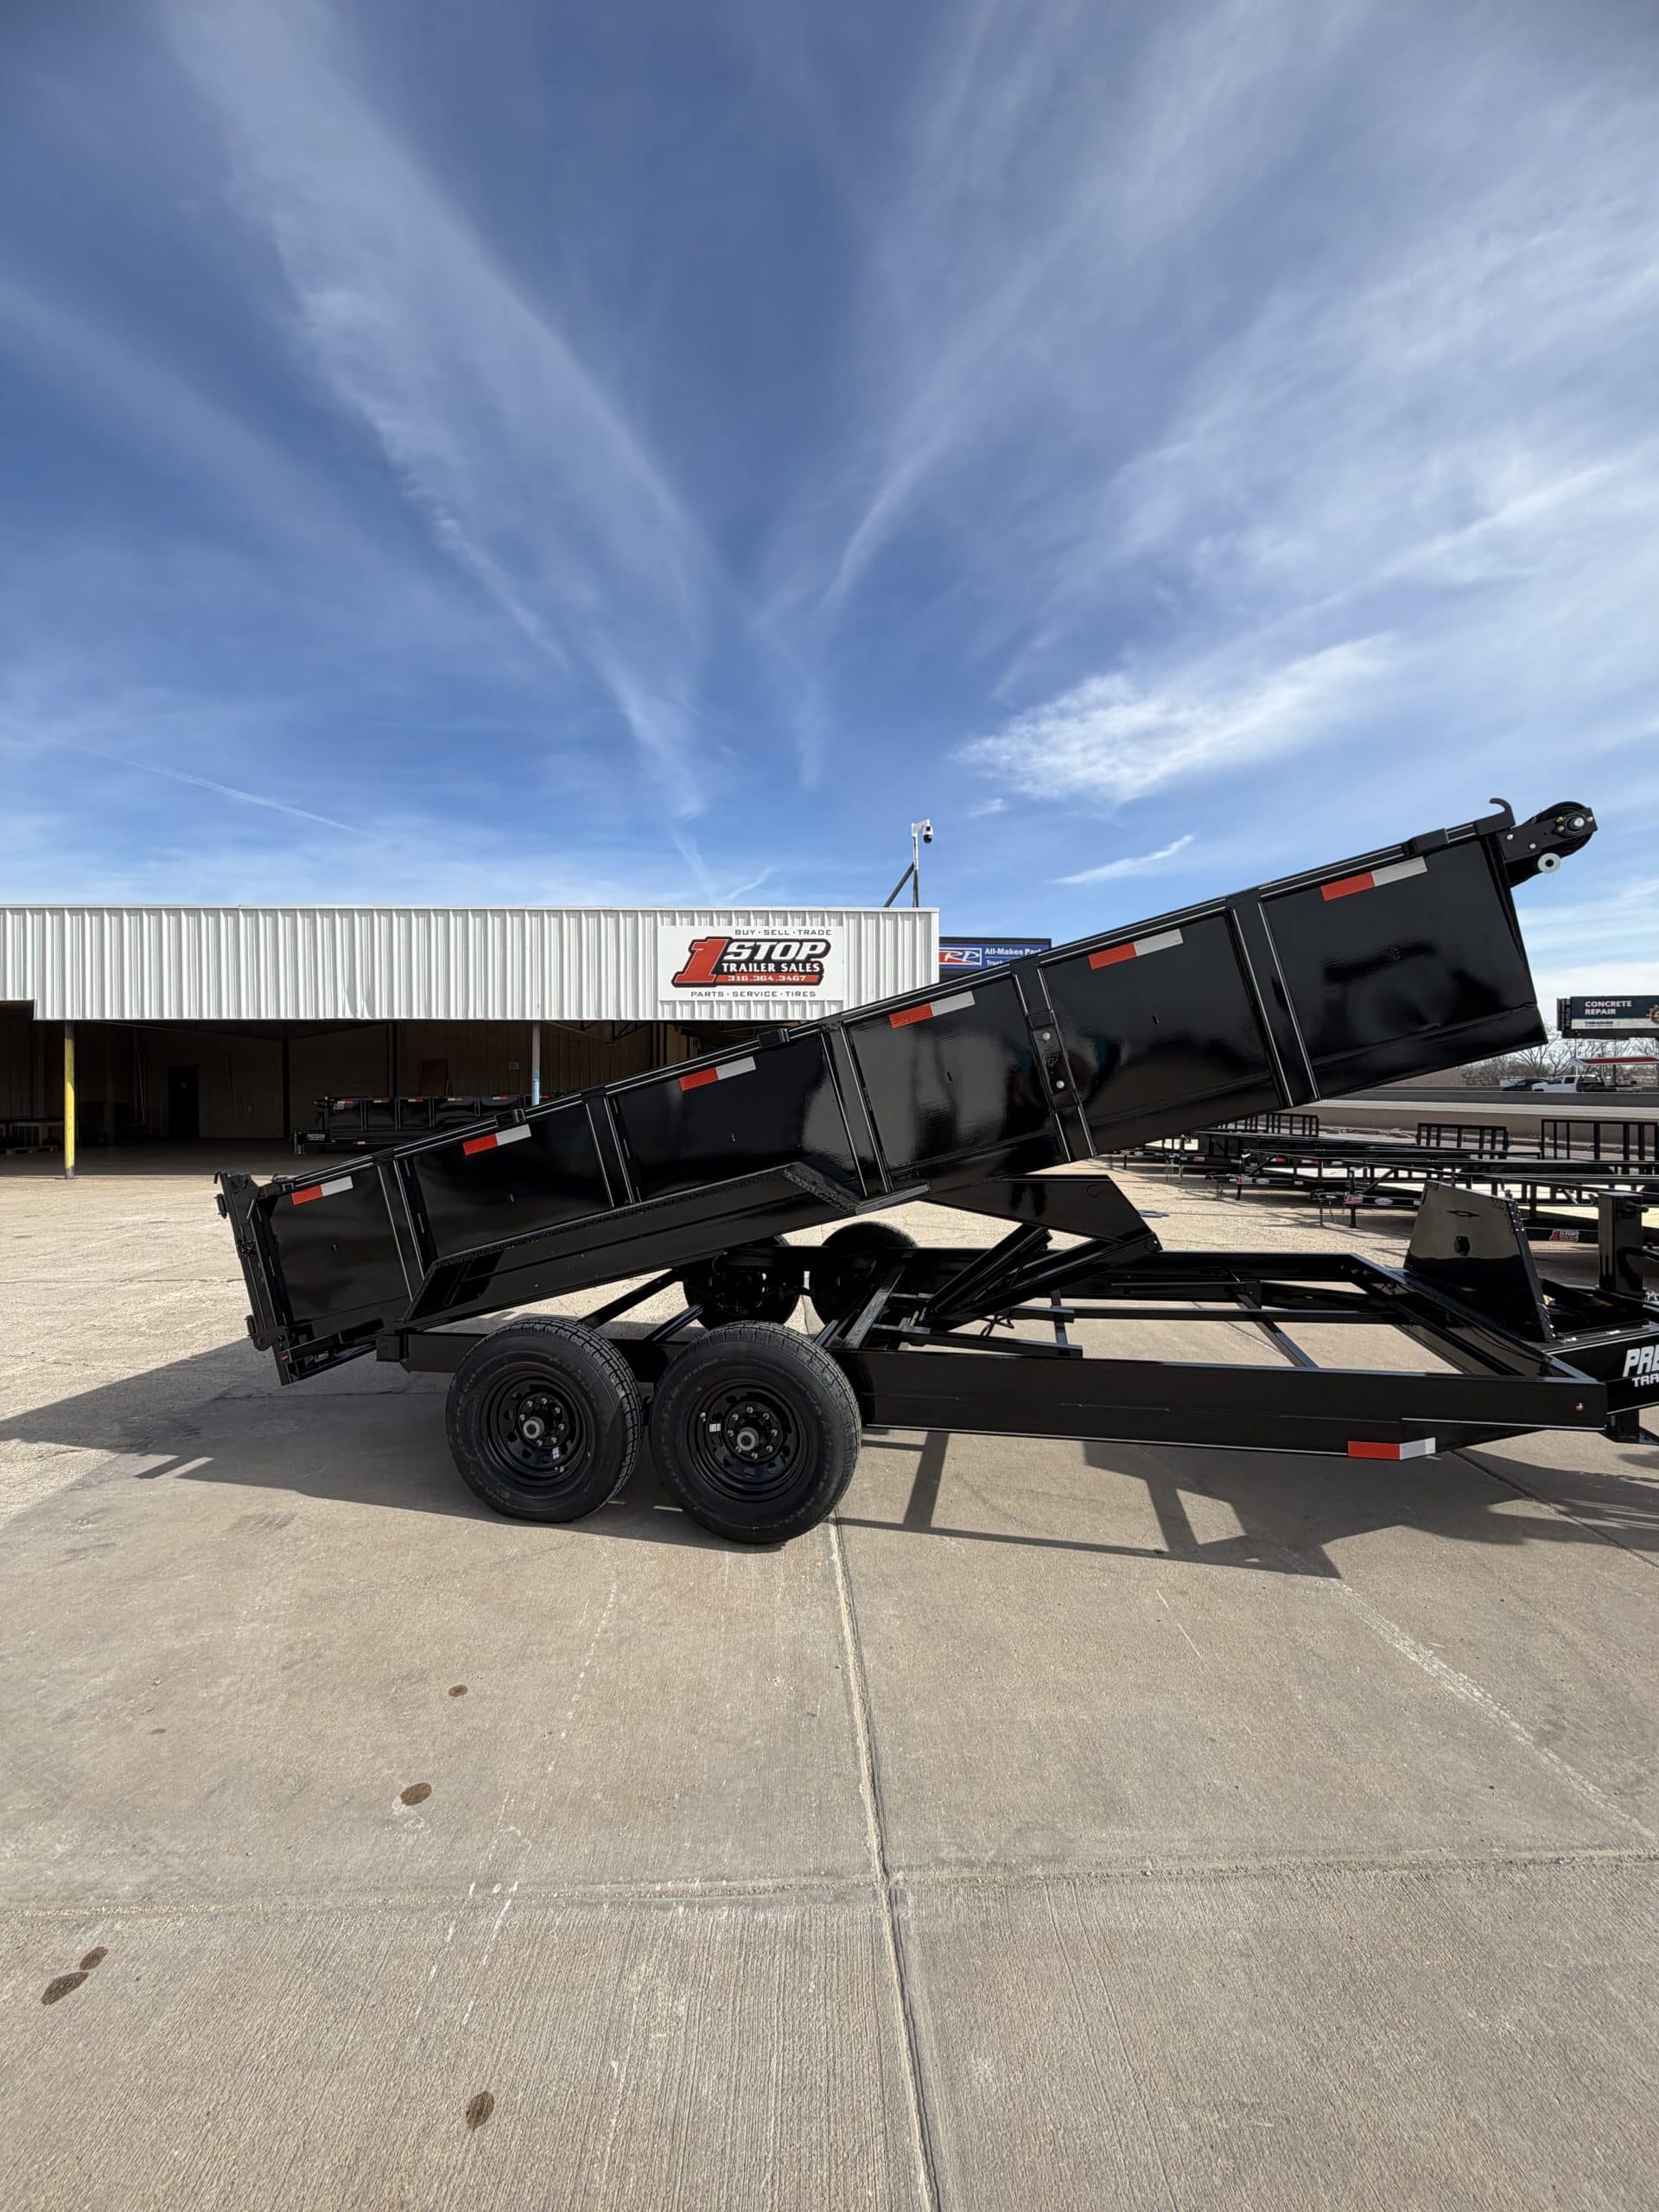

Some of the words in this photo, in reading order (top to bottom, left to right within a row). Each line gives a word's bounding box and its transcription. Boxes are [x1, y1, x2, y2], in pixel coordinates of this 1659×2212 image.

[674, 938, 728, 983] 1
[723, 942, 827, 961] STOP
[721, 963, 776, 973] TRAILER
[780, 963, 821, 973] SALES
